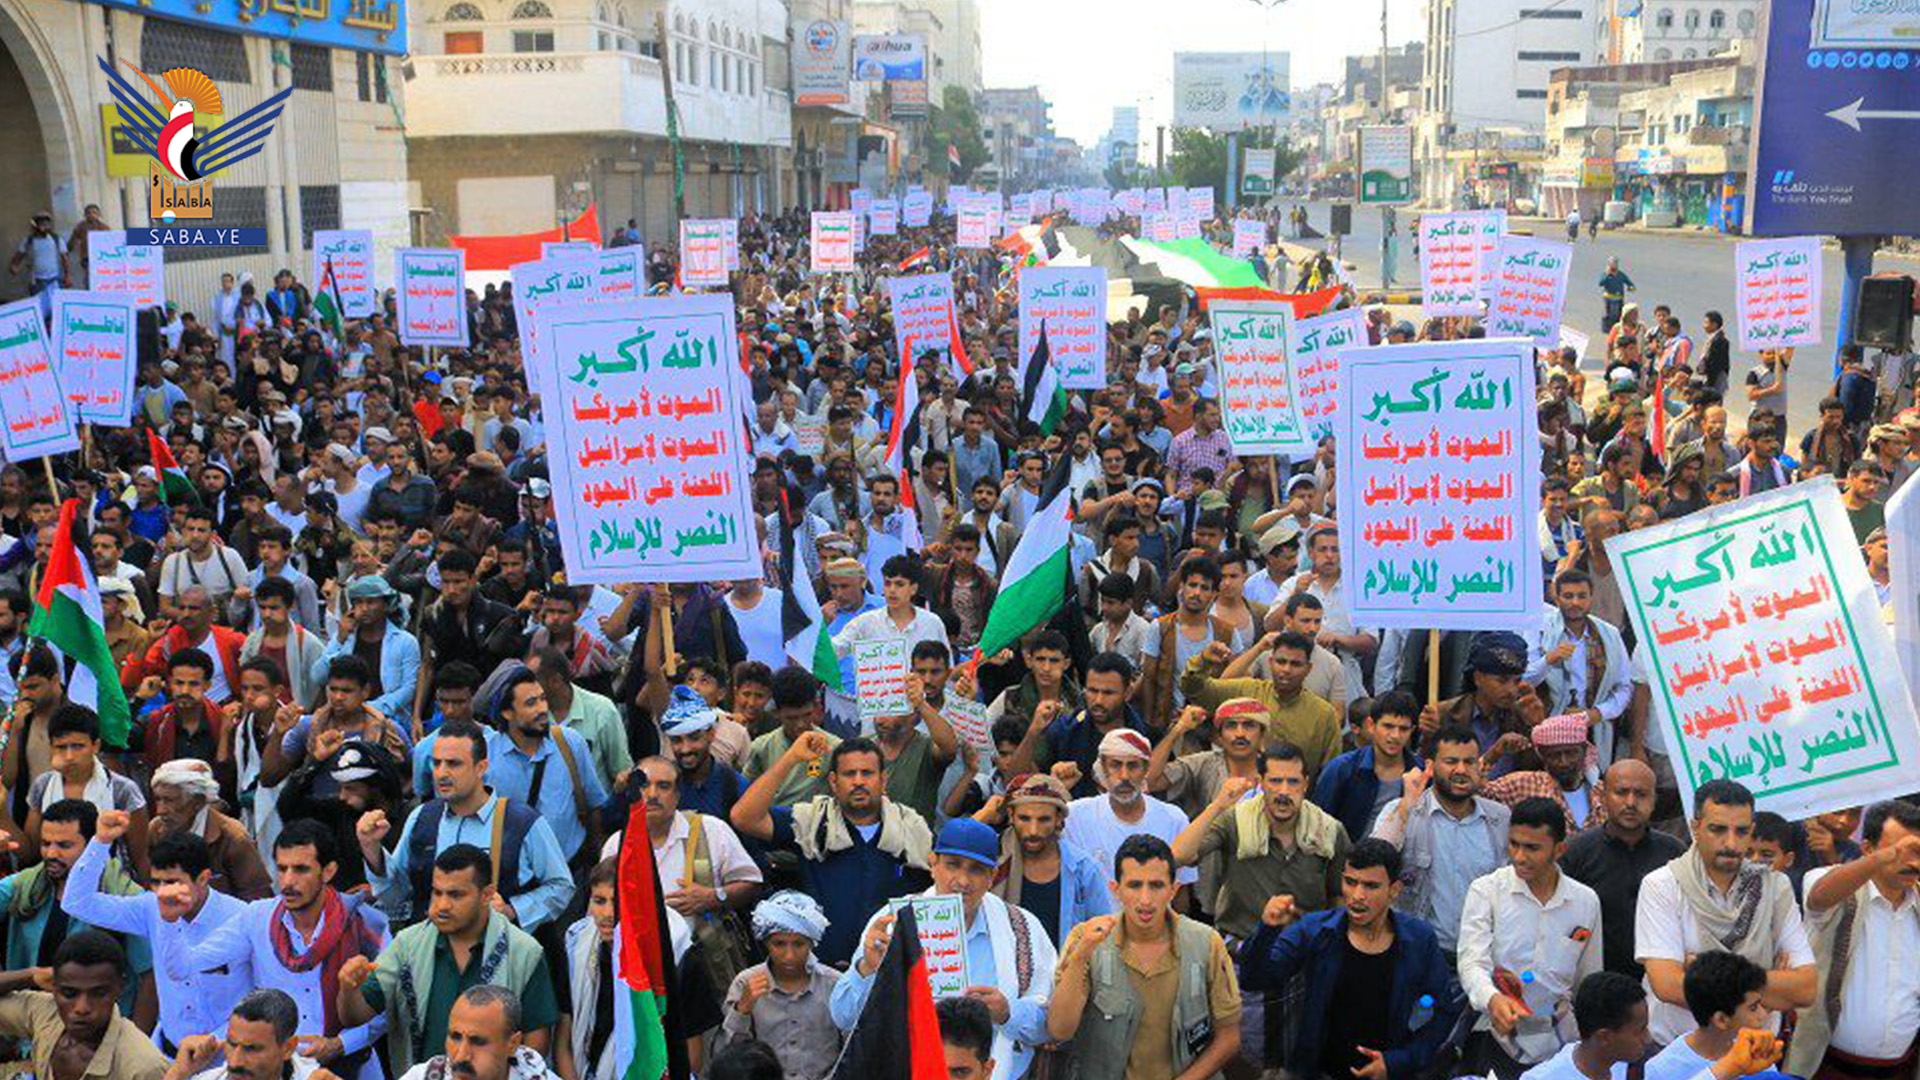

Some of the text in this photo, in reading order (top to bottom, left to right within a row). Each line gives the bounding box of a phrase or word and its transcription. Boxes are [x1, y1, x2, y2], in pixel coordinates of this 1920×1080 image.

[525, 272, 562, 300] أكبر
[566, 273, 591, 290] الله
[568, 326, 656, 387] أكبر
[661, 328, 716, 368] الله
[573, 385, 722, 425] الموت لأمريكا
[1362, 366, 1450, 427] أكبر
[1455, 369, 1512, 409] الله
[578, 430, 727, 467] الموت لإسرائيل
[1363, 425, 1440, 464] لأمريكا
[1447, 428, 1512, 464] الموت
[583, 471, 731, 508] اللعنة على اليهود
[1363, 473, 1512, 506] الموت لإسرائيل
[589, 509, 736, 560] النصر للإسلام
[1363, 515, 1512, 547] اللعنة على اليهود
[1364, 555, 1513, 605] النصر للإسلام
[1645, 522, 1814, 609] الله أكبر
[1652, 572, 1831, 645] الموت لأمريكا
[1671, 617, 1846, 697] الموت لإسرائيل
[1683, 664, 1863, 740] اللعنة على اليهود
[1798, 707, 1879, 774] النصر
